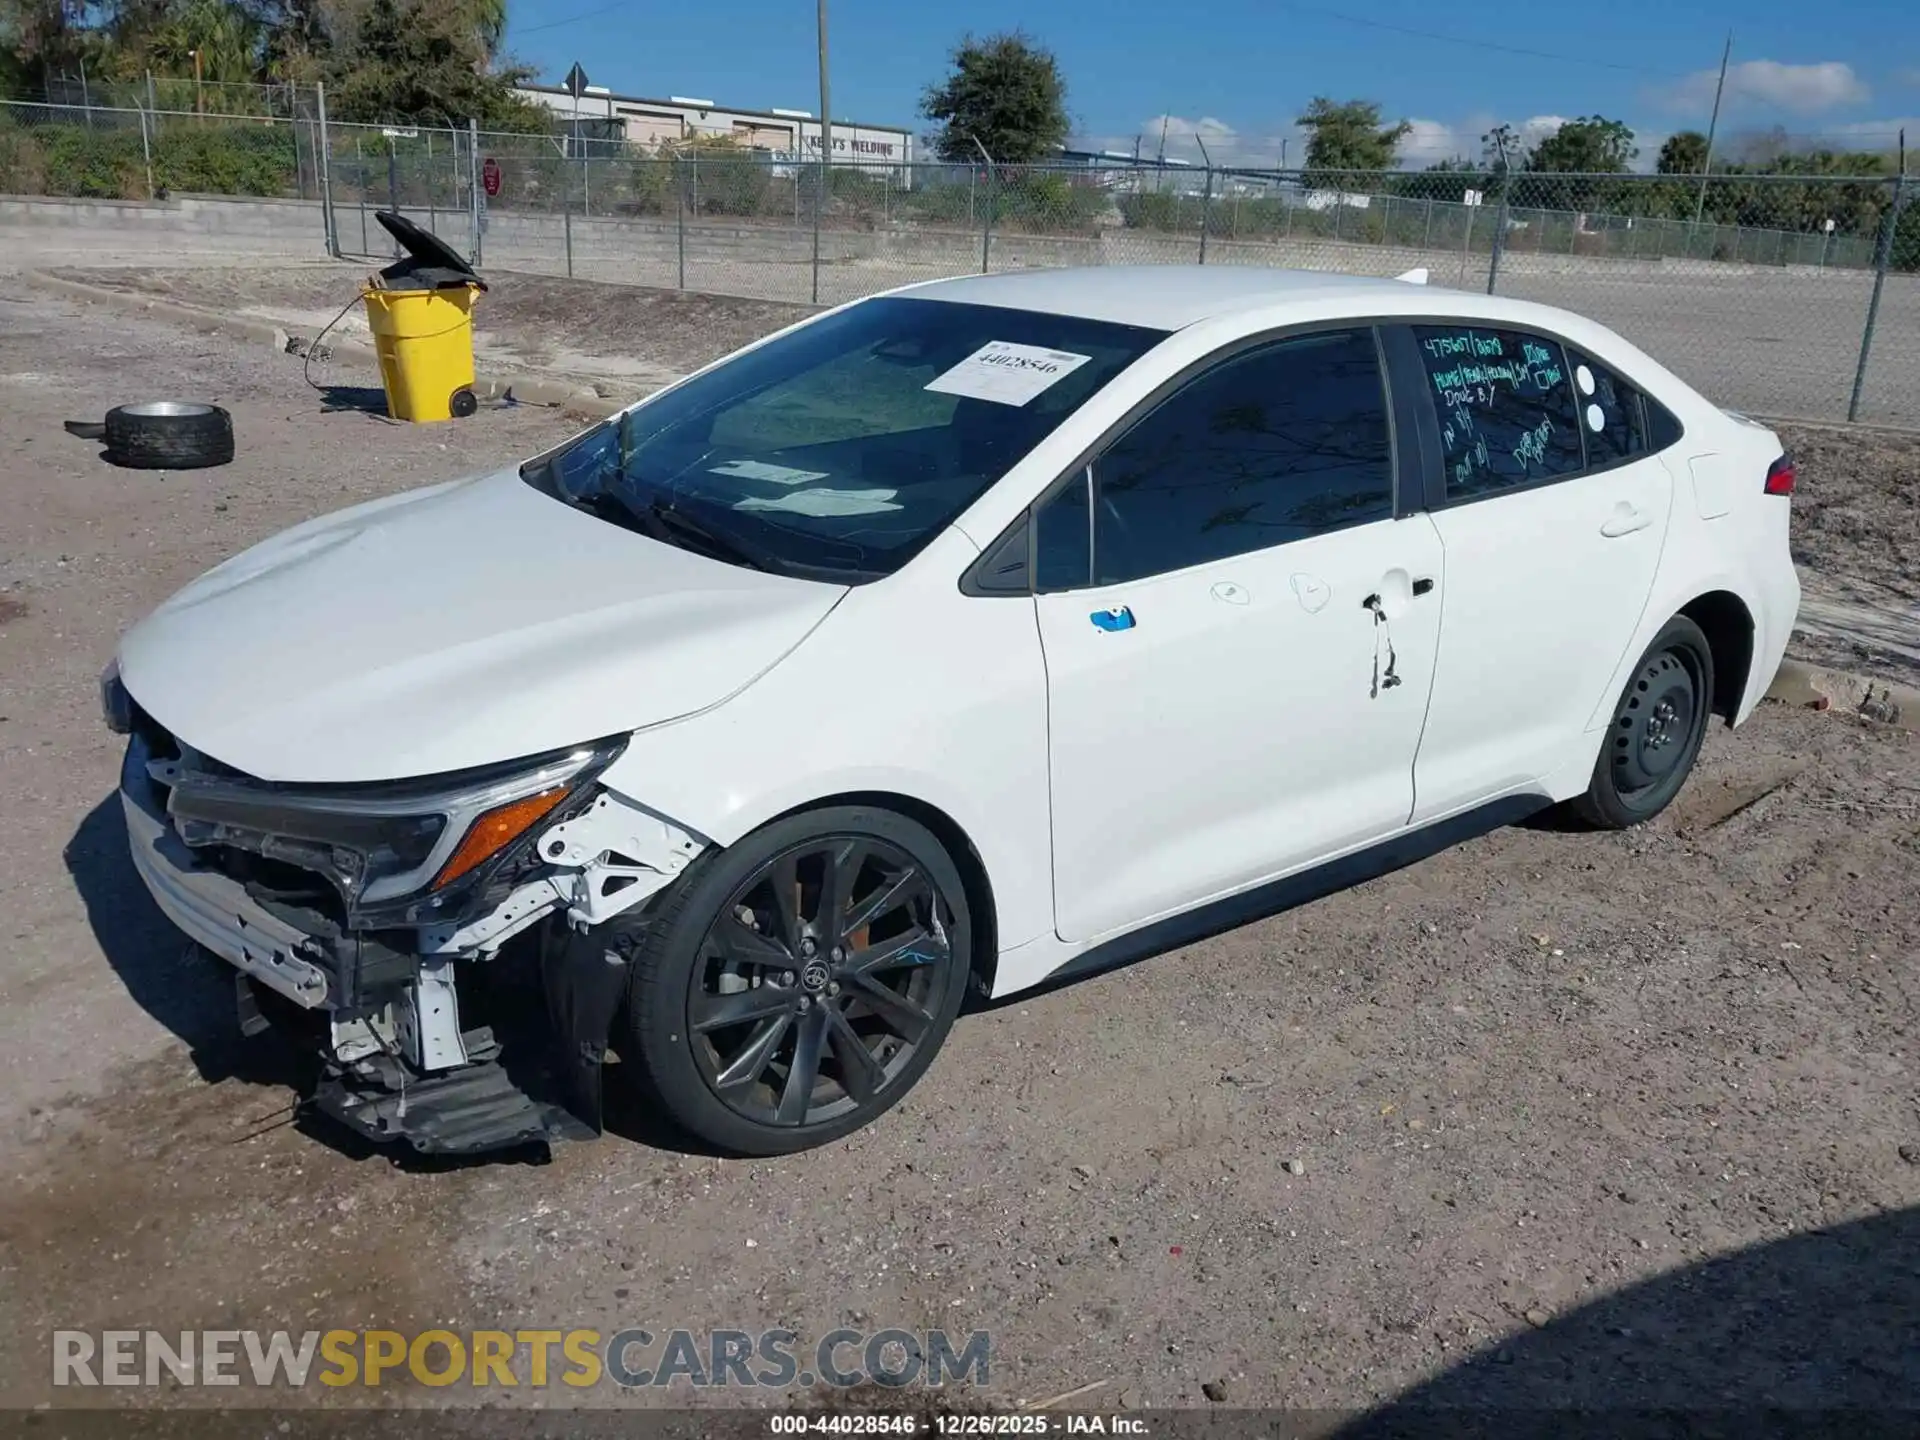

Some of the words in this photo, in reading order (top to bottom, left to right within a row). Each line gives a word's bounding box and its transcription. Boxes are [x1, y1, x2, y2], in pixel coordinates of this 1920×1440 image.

[810, 135, 846, 151] KEY'S
[851, 140, 894, 156] WELDING
[979, 353, 1058, 374] 44028546
